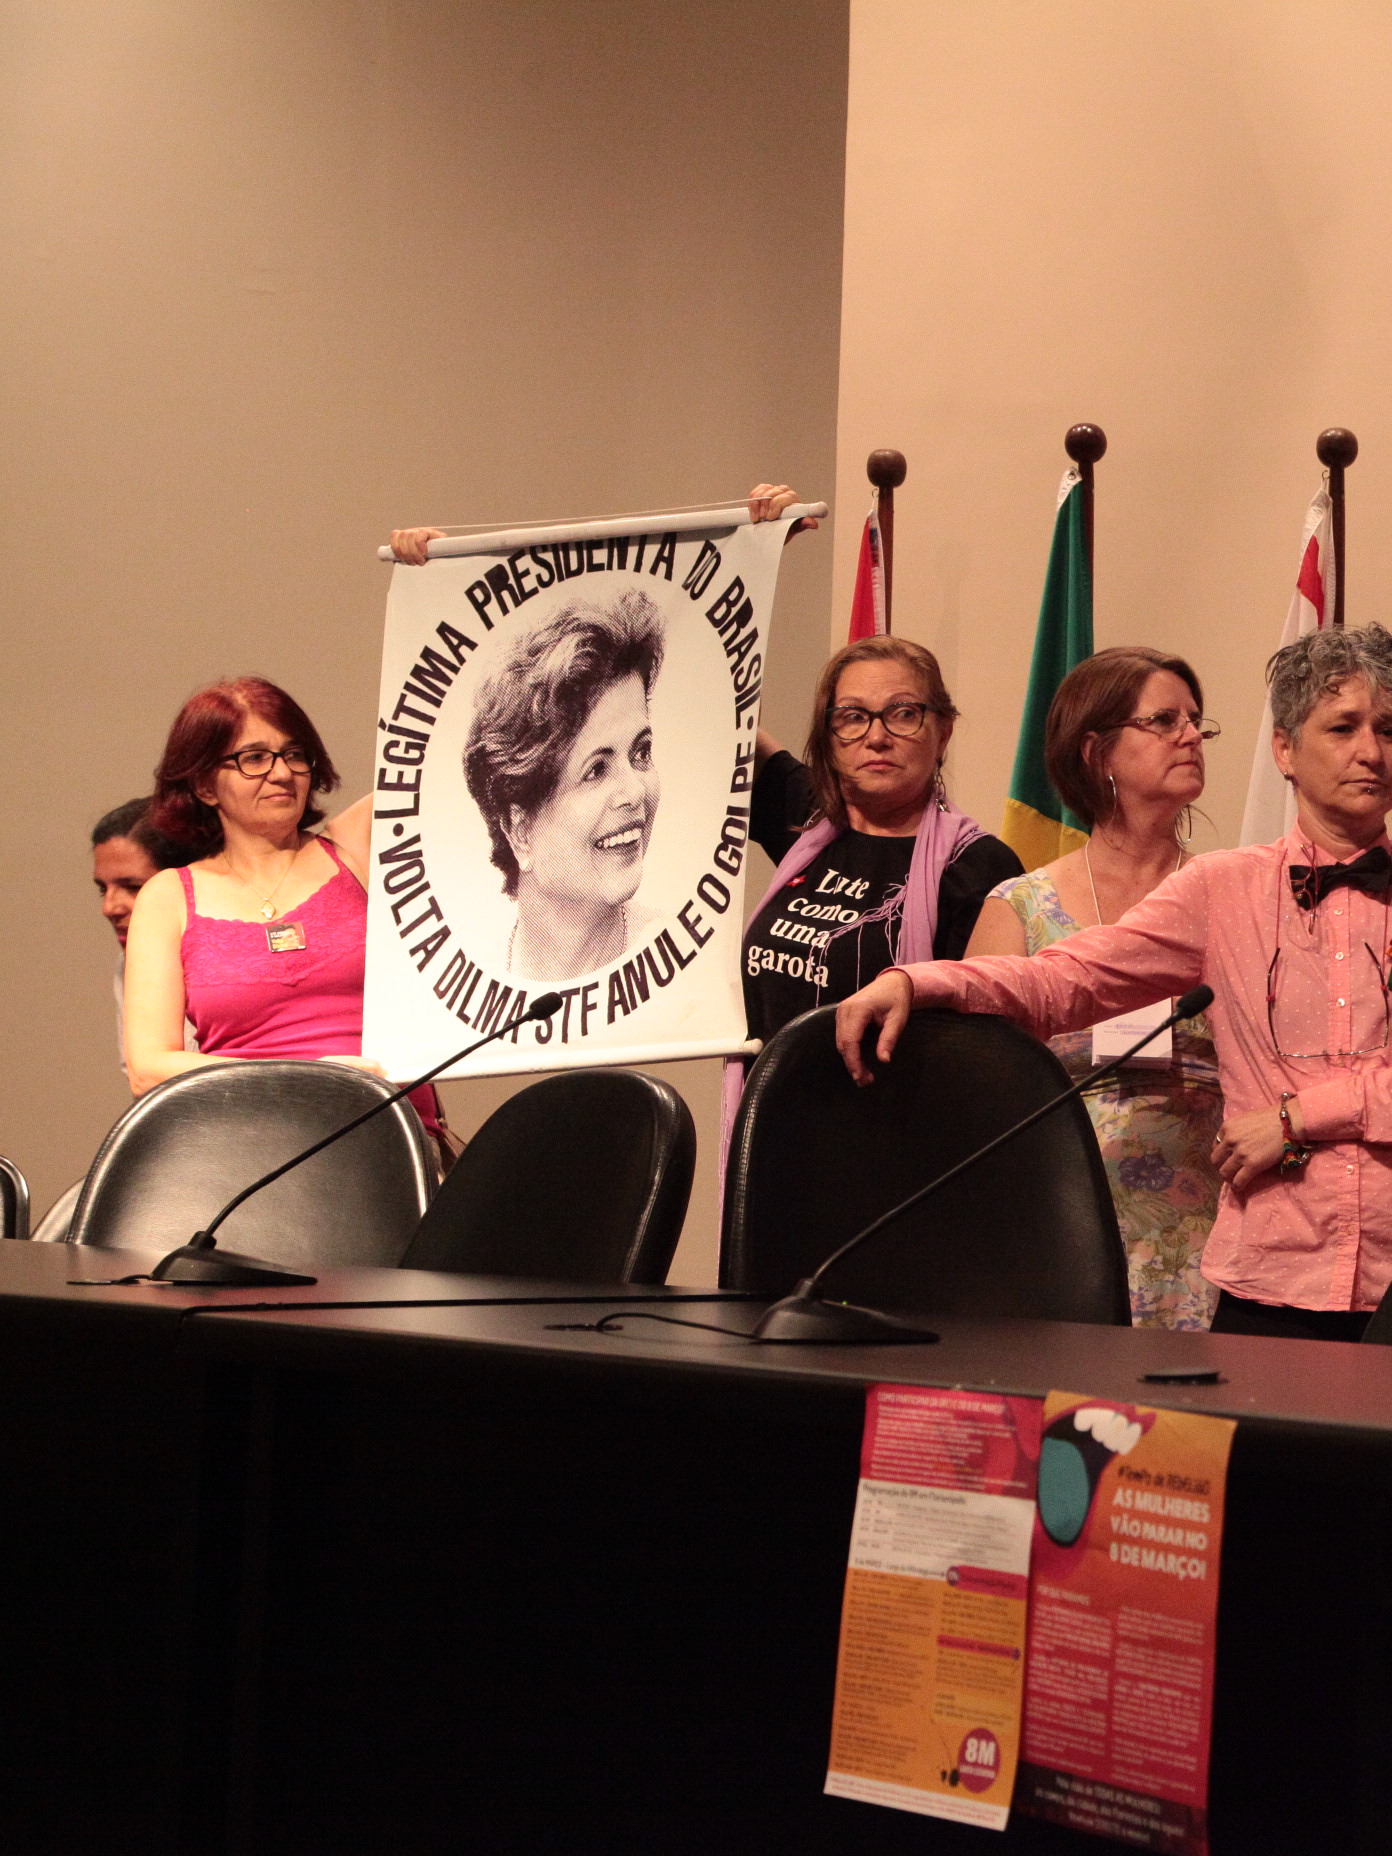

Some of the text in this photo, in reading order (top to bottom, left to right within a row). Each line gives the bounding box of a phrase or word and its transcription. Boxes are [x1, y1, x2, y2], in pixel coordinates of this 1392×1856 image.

[374, 620, 479, 819] LEGÍTIMA
[682, 540, 721, 600] DO
[705, 575, 762, 730] BRASIL
[787, 897, 860, 923] como
[379, 833, 451, 973] VOLTA
[433, 948, 527, 1044] DILMA
[607, 899, 714, 1025] ANULE
[697, 873, 731, 914] O
[770, 918, 830, 948] uma
[747, 945, 829, 987] garota
[1112, 1487, 1210, 1523] AS MULHERES
[1110, 1513, 1208, 1551] VÃO PARAR NO
[1120, 1544, 1140, 1567] DE
[964, 1737, 996, 1767] 8M
